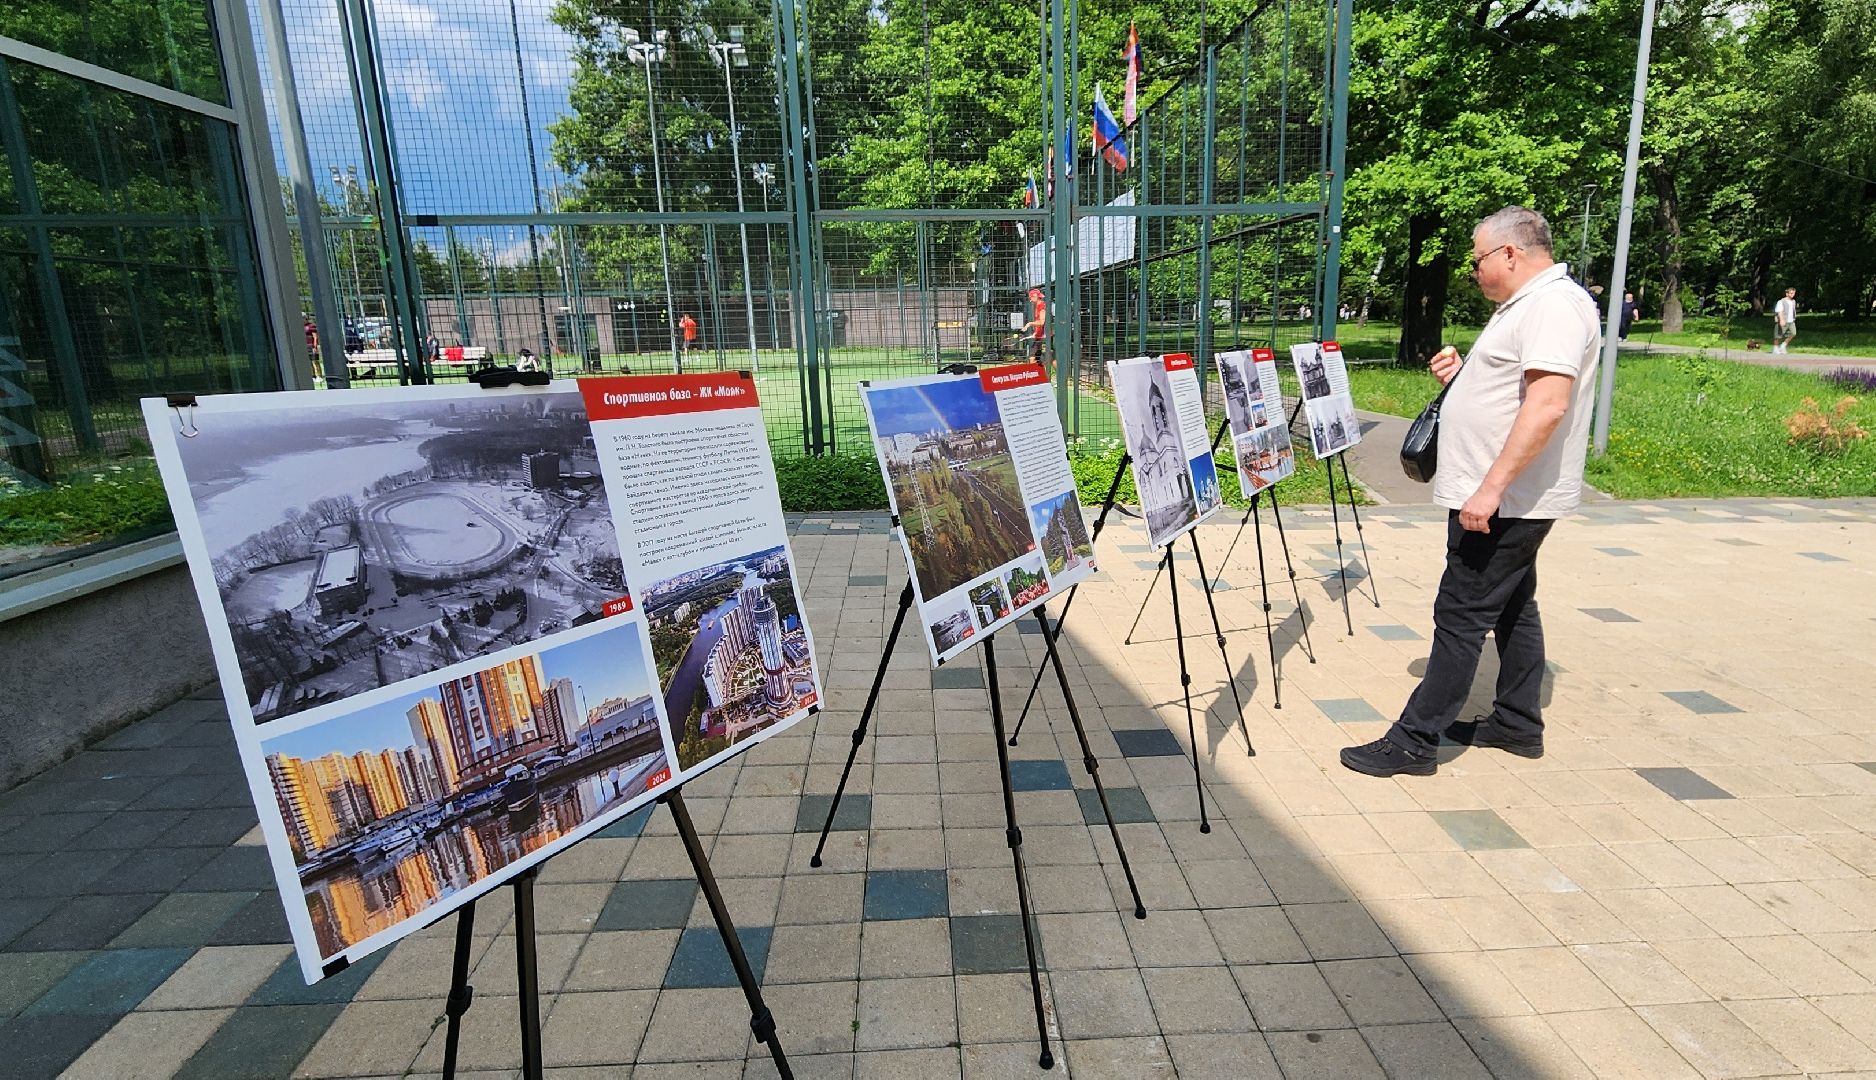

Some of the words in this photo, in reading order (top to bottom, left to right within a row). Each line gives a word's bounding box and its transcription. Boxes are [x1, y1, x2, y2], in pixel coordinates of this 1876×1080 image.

[604, 391, 667, 407] Спортивная
[670, 388, 691, 400] база
[699, 386, 712, 397] ЖК
[714, 386, 745, 397] «Маяк»
[651, 431, 669, 439] берегу
[610, 600, 626, 613] 1989
[652, 771, 666, 786] 2024
